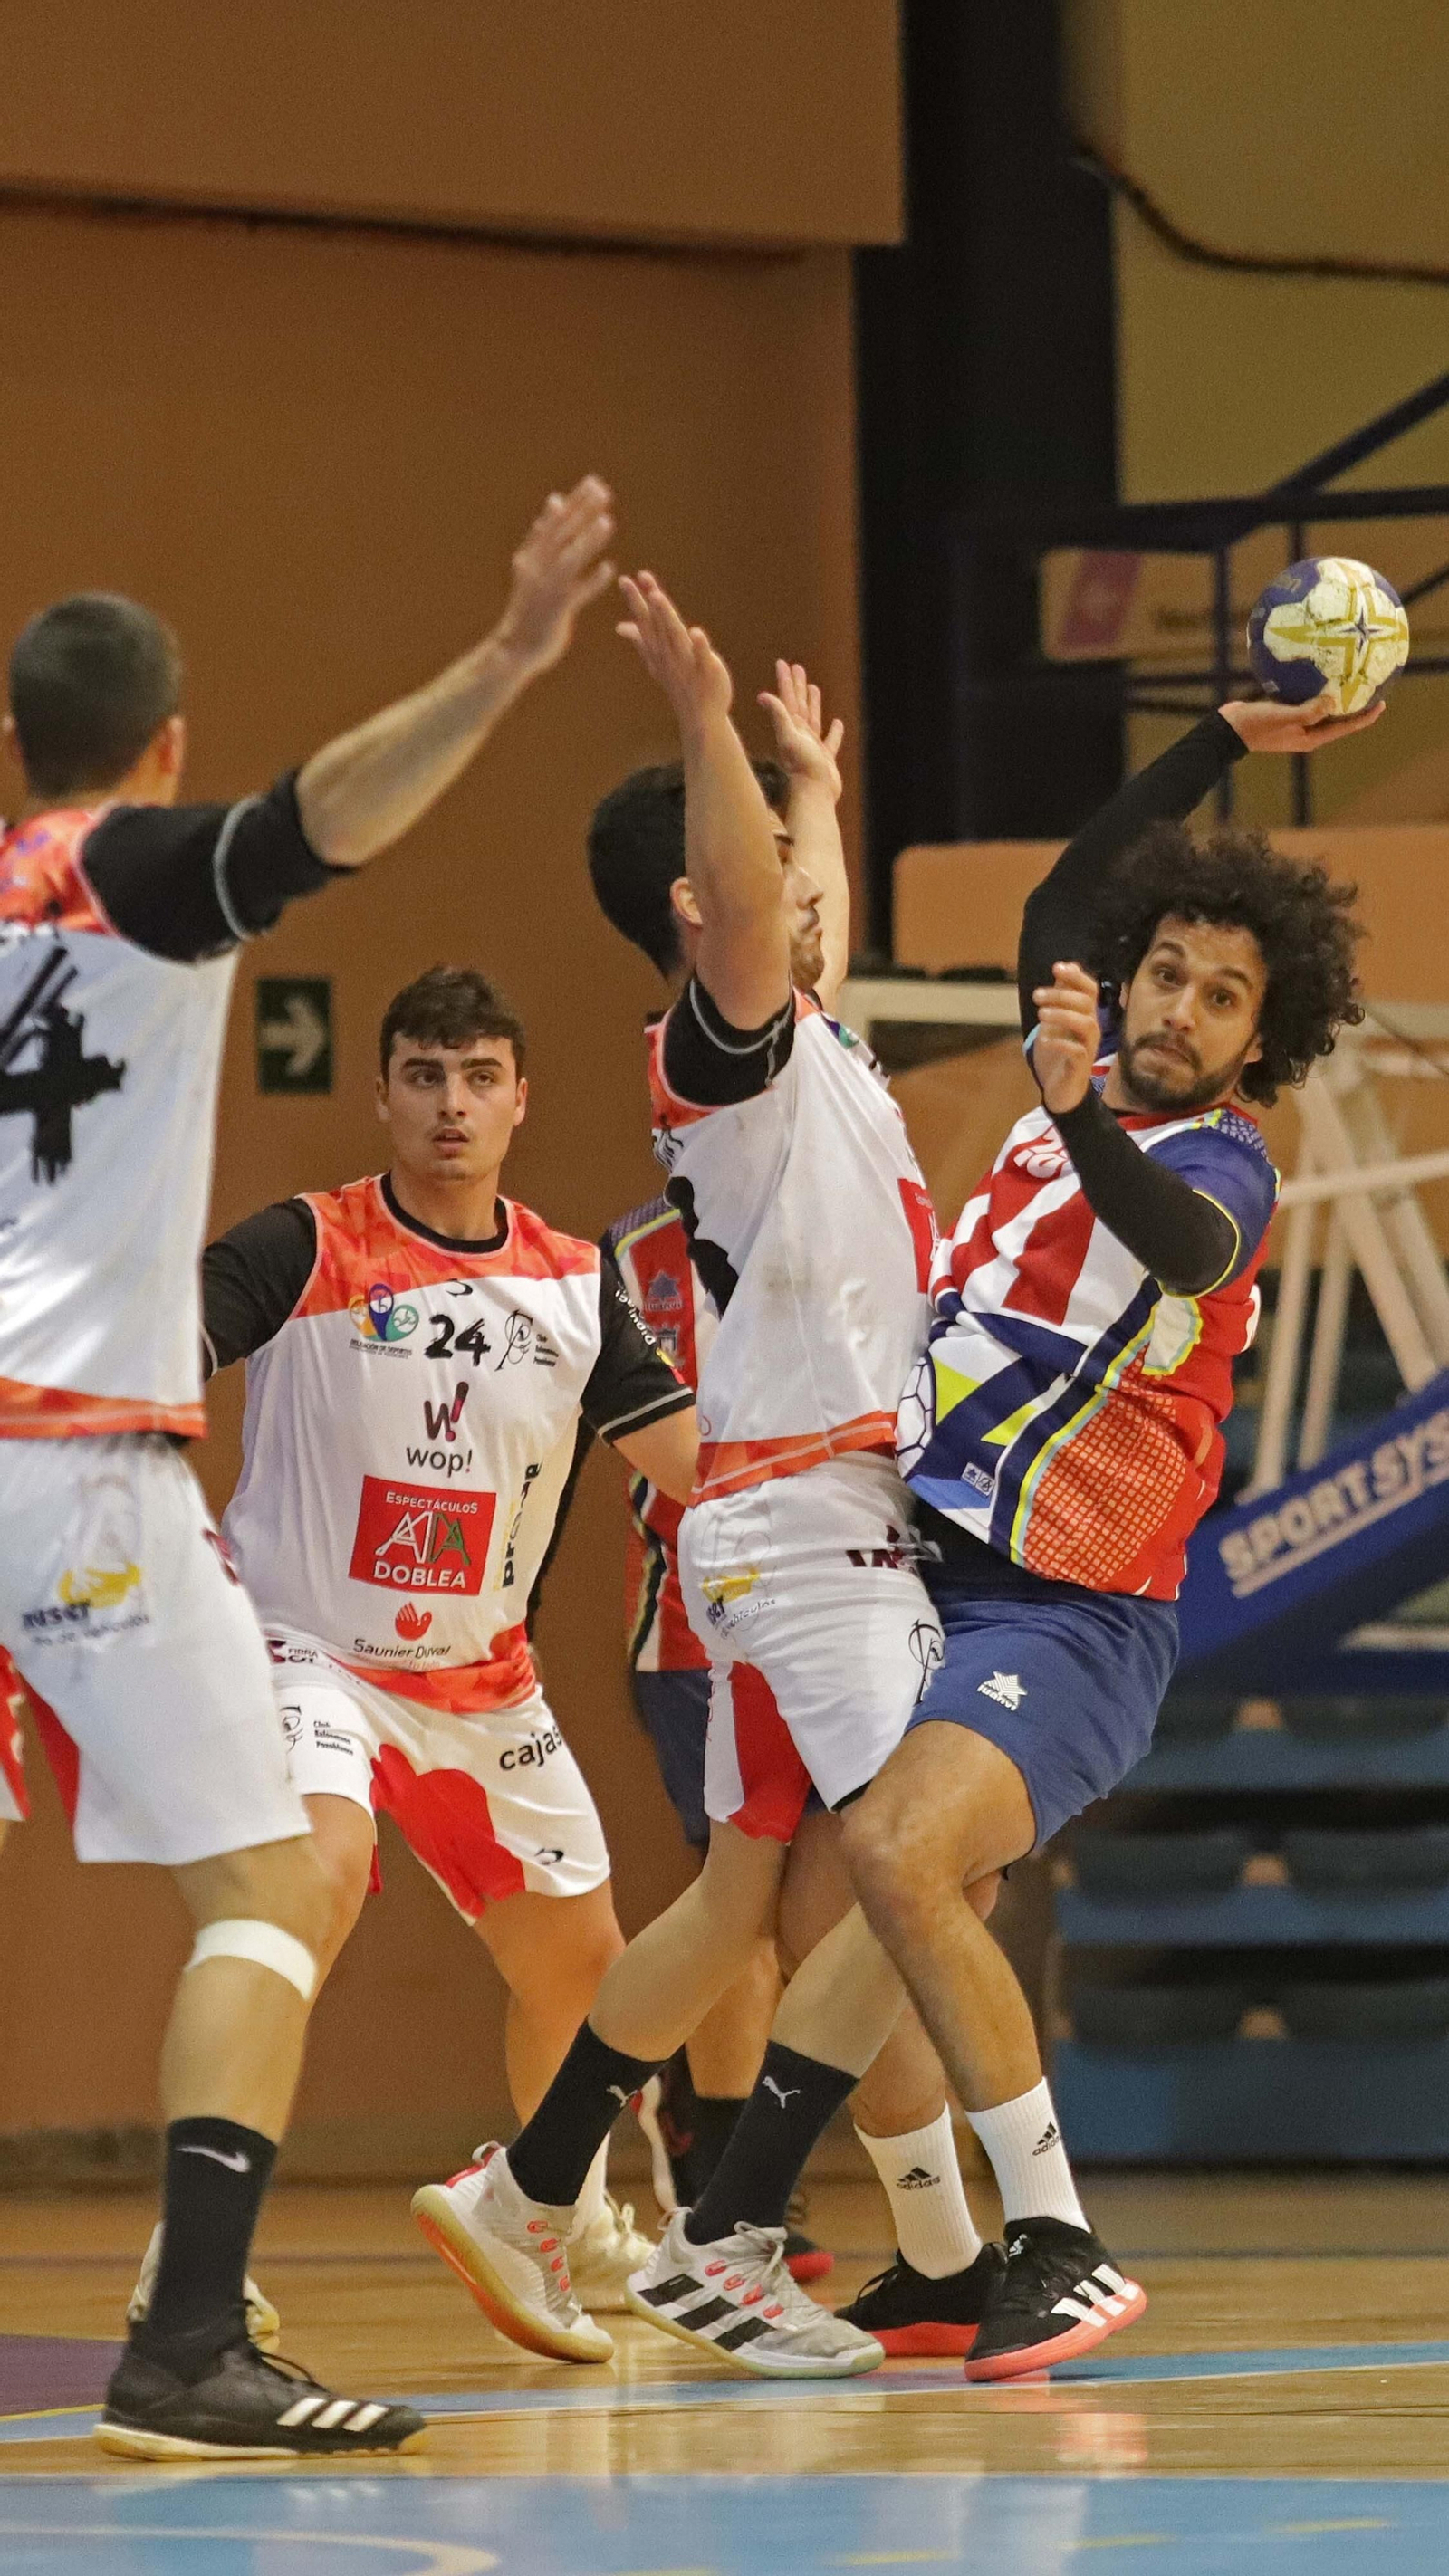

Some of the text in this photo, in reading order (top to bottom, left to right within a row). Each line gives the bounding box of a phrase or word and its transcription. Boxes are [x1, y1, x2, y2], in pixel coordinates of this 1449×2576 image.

[425, 1314, 491, 1366] 24
[406, 1447, 472, 1478] wop!
[373, 1560, 466, 1589] DOBLEA
[353, 1638, 451, 1659] Saunier Duval
